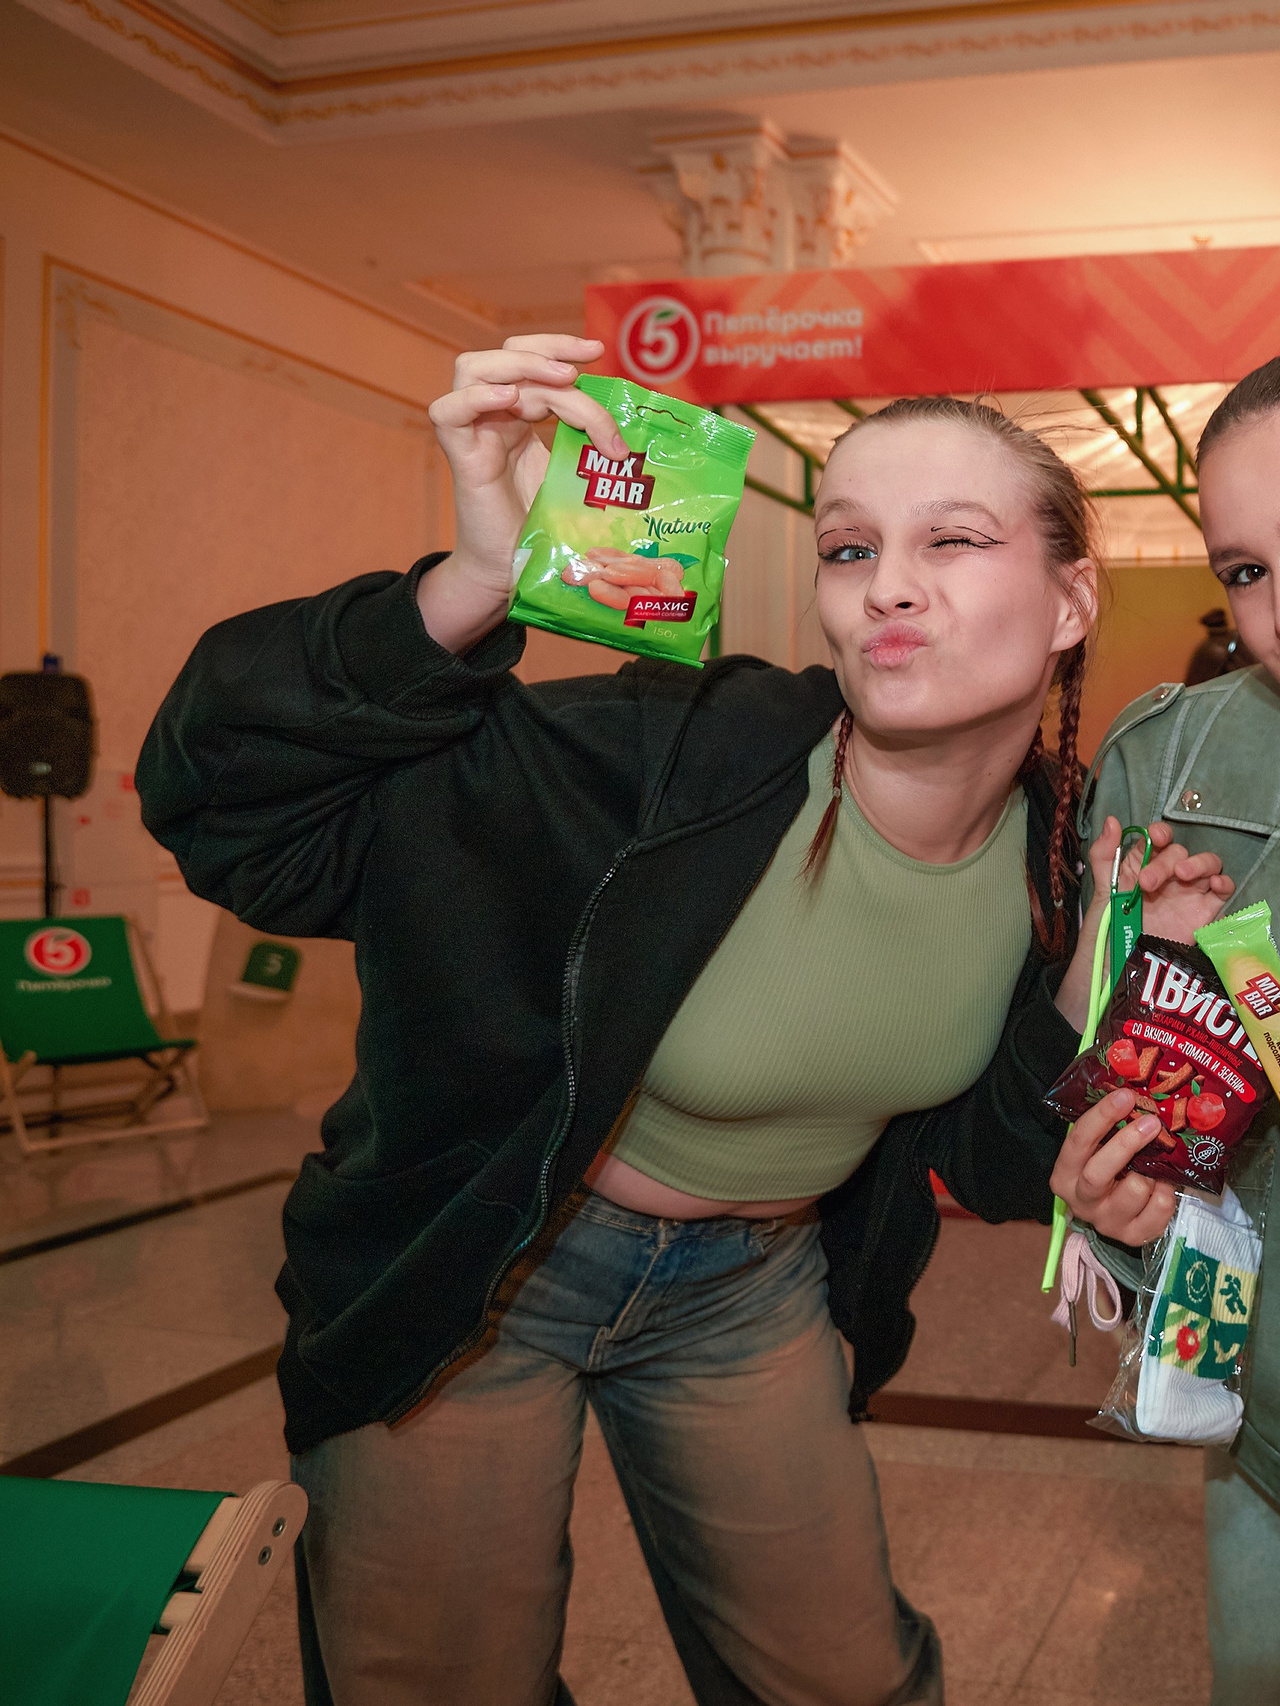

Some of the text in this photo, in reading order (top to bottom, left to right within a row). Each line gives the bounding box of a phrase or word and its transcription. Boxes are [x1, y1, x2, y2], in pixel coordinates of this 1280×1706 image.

[704, 306, 864, 337] Пятёрочка
[704, 336, 863, 368] выручает!
[585, 449, 637, 478] MIX
[594, 477, 646, 505] BAR
[646, 516, 712, 539] Nature
[634, 601, 690, 612] АРАХИС
[1243, 990, 1273, 1016] BAR
[1151, 1012, 1185, 1031] СУХАРИКИ
[1131, 1022, 1245, 1094] СО ВКУСОМ «ТОМАТА И ЗЕЛЕНИ»
